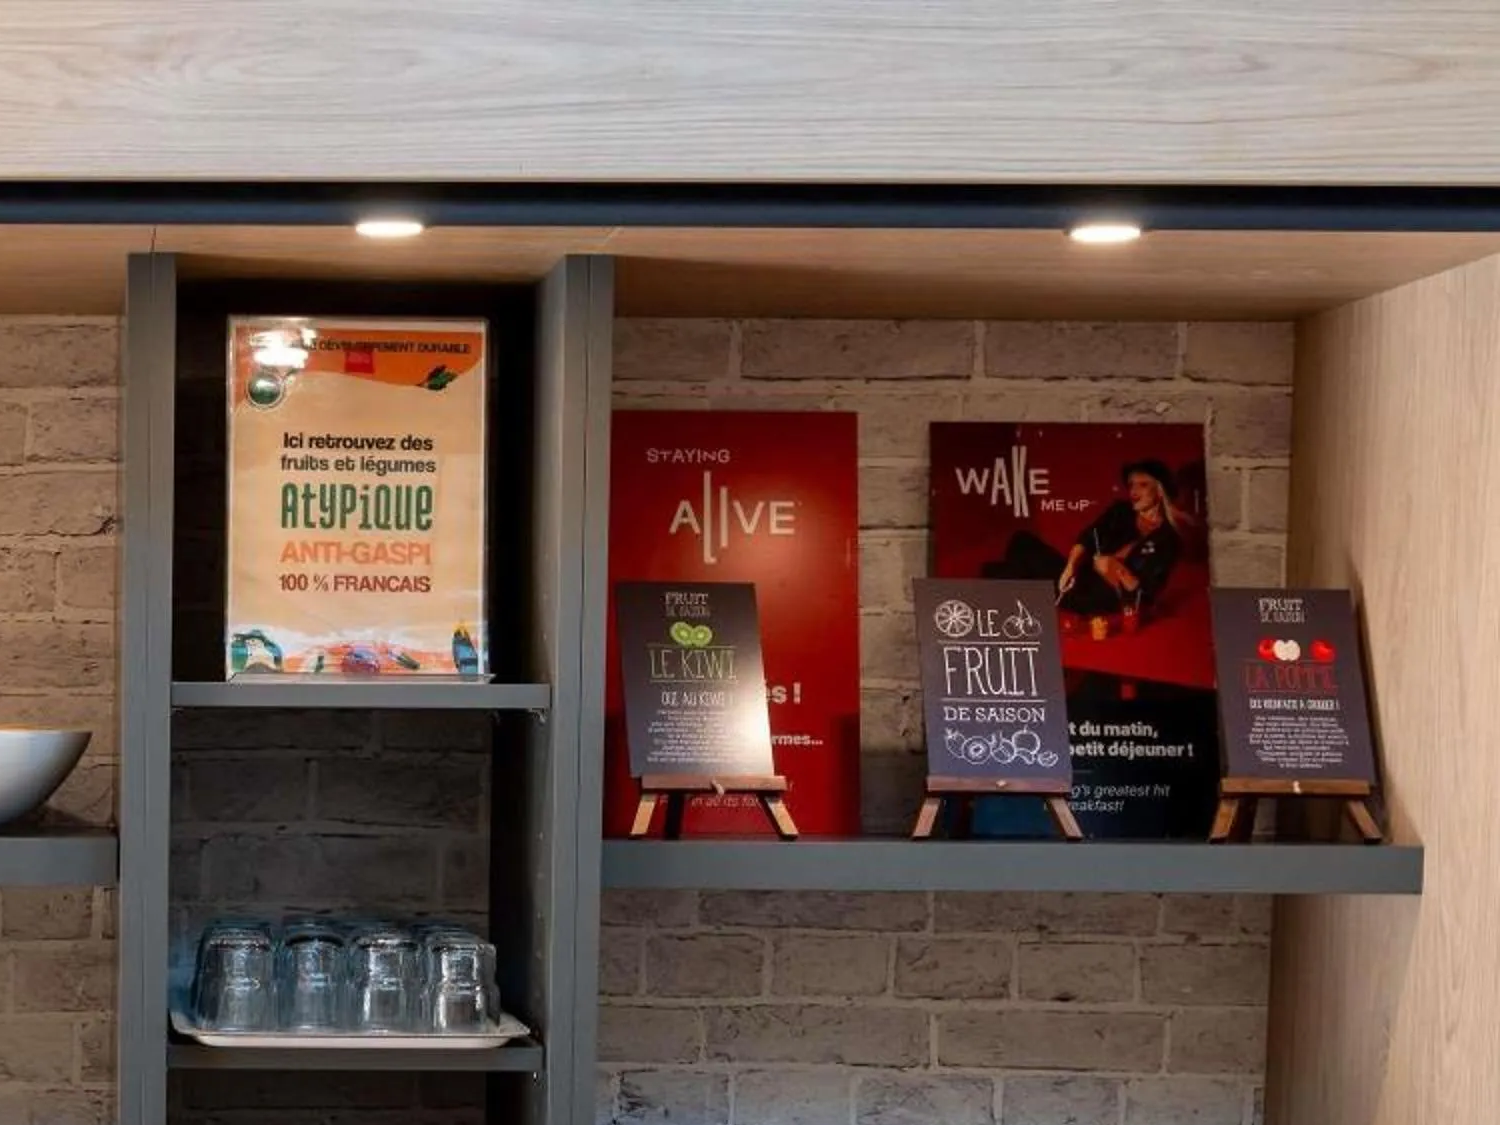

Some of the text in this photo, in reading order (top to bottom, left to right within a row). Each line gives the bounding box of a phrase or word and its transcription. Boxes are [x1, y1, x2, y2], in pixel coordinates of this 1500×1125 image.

[283, 432, 433, 451] Ici retrouvez des
[281, 454, 436, 476] fruits et légumes
[647, 448, 731, 464] STAYING
[955, 445, 1050, 518] WAKE
[1041, 499, 1091, 511] ME UP
[669, 470, 795, 564] ALIVE
[280, 540, 431, 565] ANTI-GASPI
[279, 574, 309, 591] 100
[314, 575, 329, 591] %
[977, 609, 1001, 637] LE
[943, 646, 1039, 696] FRUIT
[943, 706, 1045, 722] DE SAISON
[1079, 721, 1100, 736] du
[1103, 721, 1159, 738] matin,
[1108, 740, 1185, 760] déjeuner
